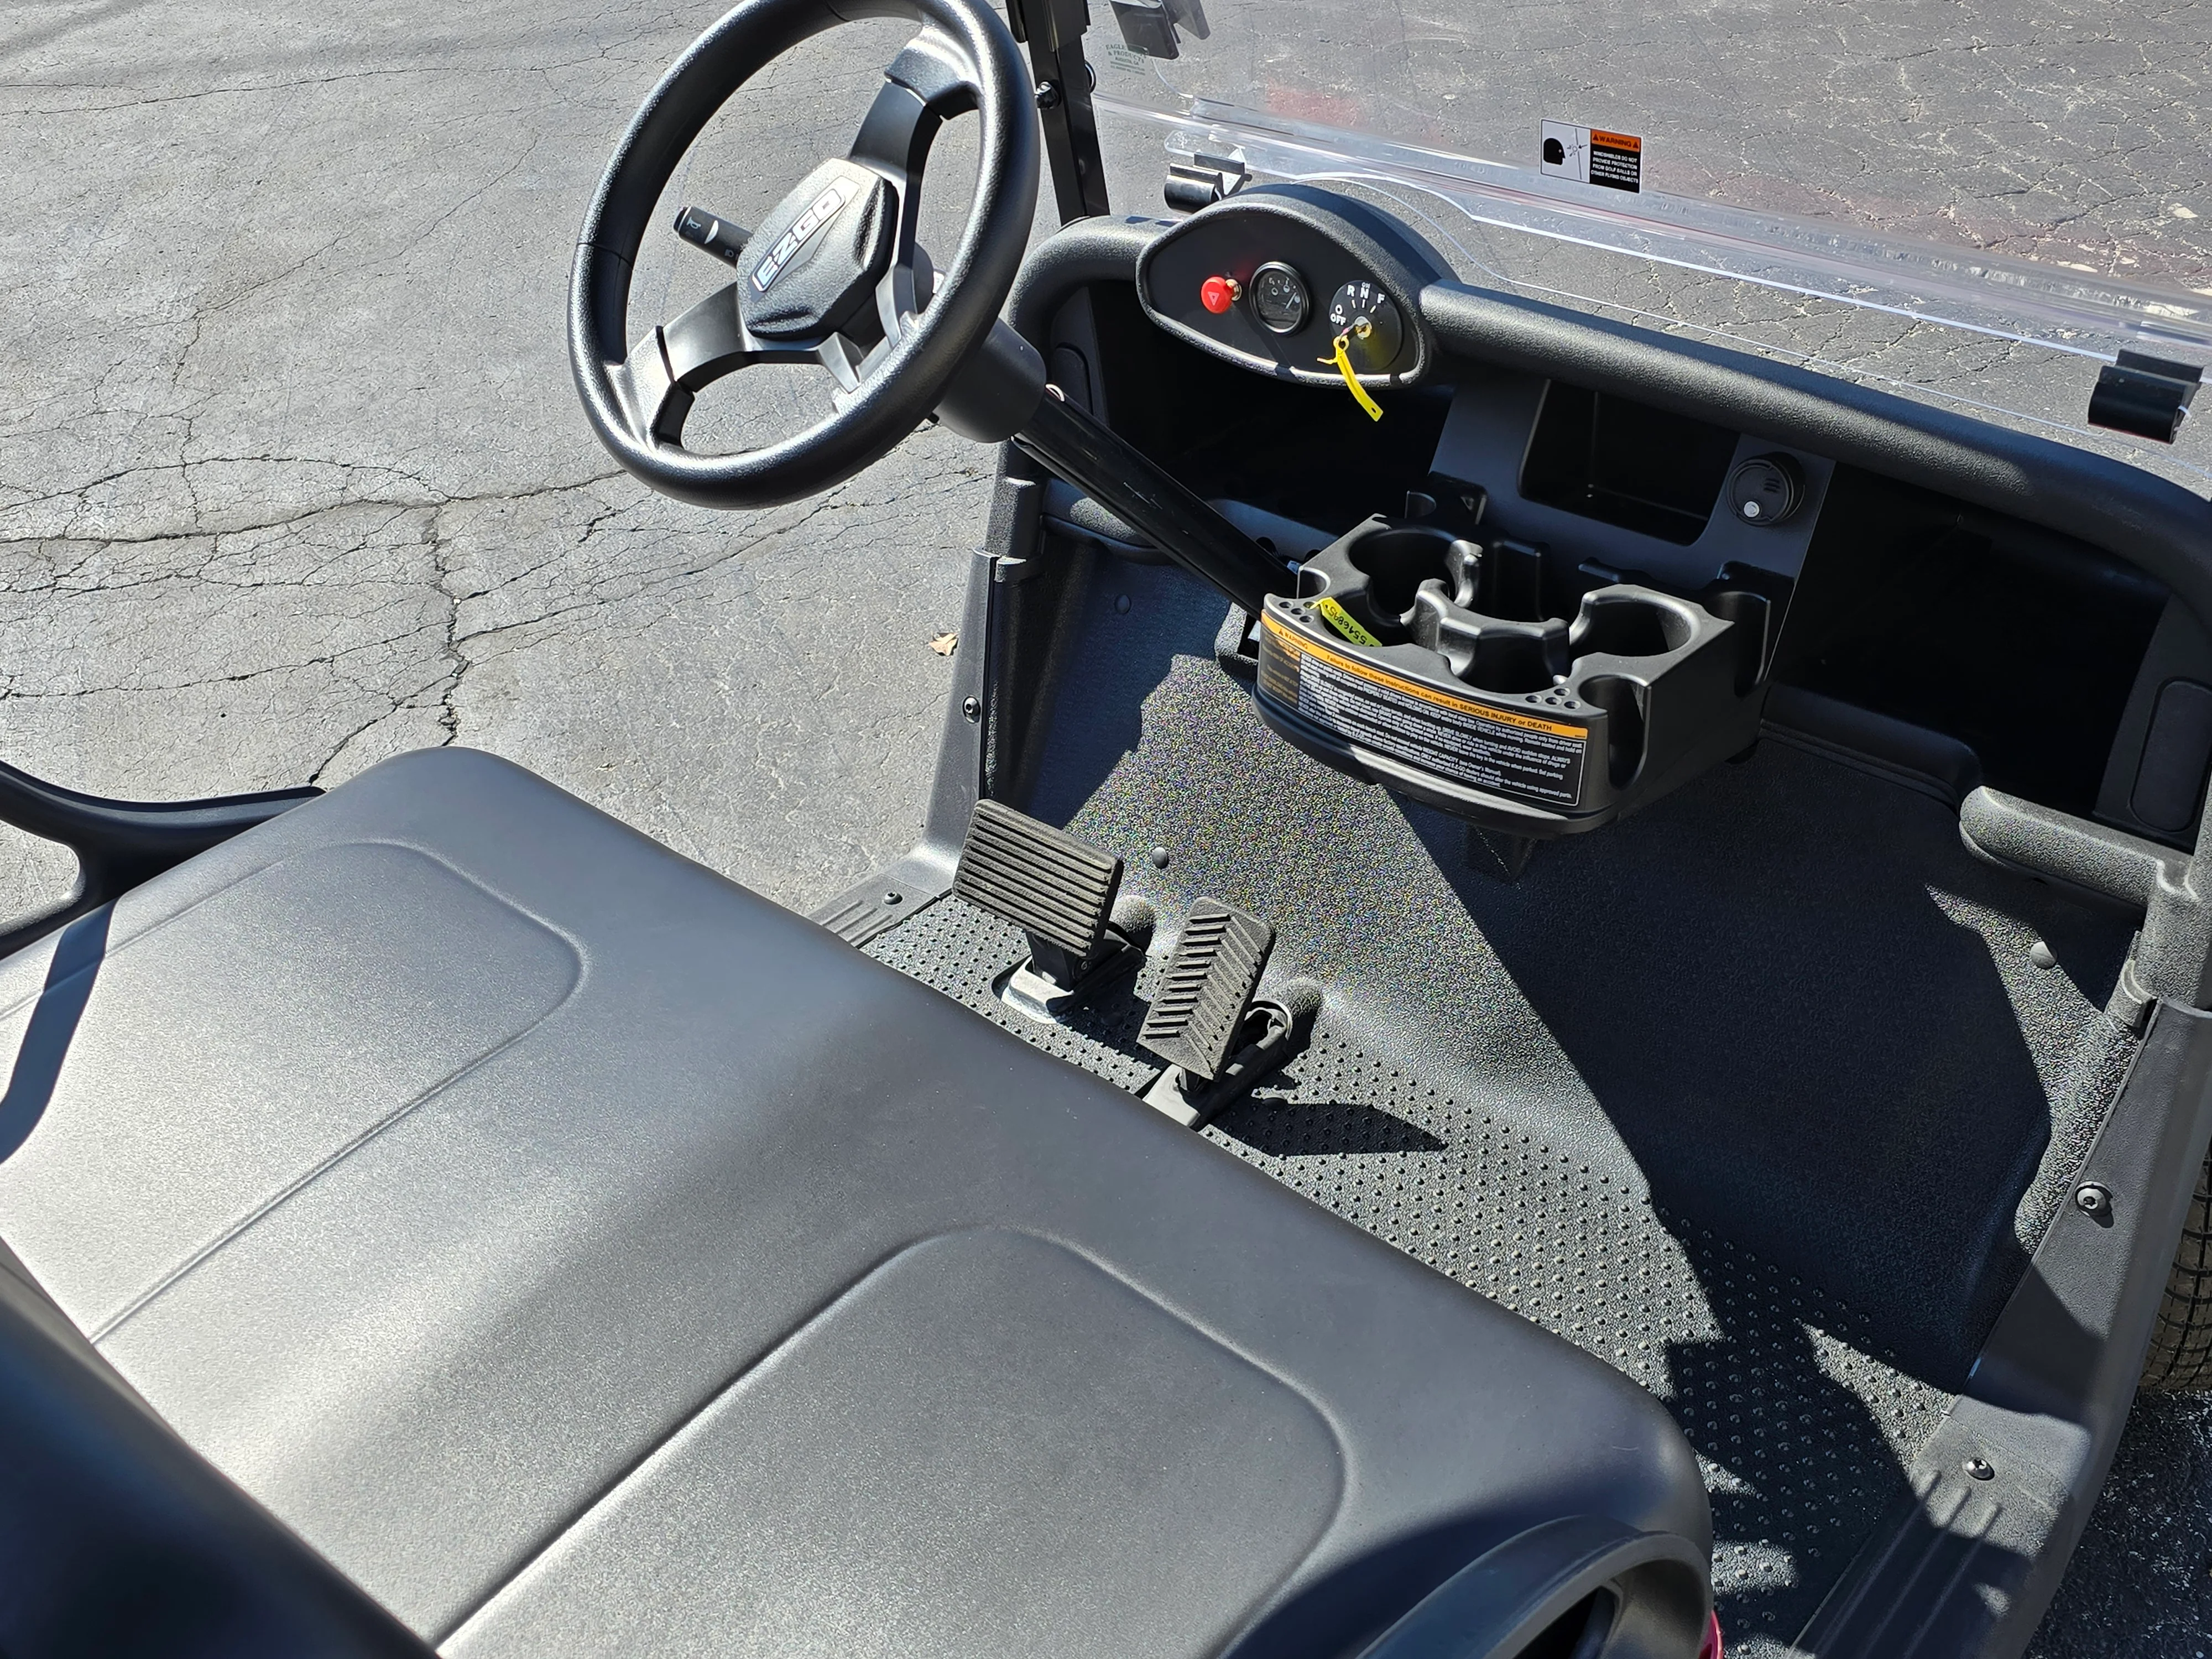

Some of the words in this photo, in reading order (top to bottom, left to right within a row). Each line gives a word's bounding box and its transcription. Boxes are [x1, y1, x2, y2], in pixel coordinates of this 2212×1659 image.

[1113, 50, 1145, 64] PRODUCTS
[1599, 135, 1631, 147] WARNING
[1611, 160, 1637, 170] PROTECTION
[1620, 175, 1639, 184] OBJECTS
[757, 189, 842, 286] EZGO
[1347, 284, 1355, 297] R
[1360, 287, 1369, 299] N
[1377, 293, 1385, 304] F
[1330, 313, 1346, 326] OFF
[1327, 655, 1344, 667] Failure
[1351, 665, 1368, 676] follow
[1369, 672, 1384, 682] these
[1385, 678, 1420, 695] instructions
[1433, 696, 1451, 706] result
[1459, 703, 1490, 717] SERIOUS
[1491, 712, 1517, 723] INJURY
[1527, 721, 1553, 731] DEATH
